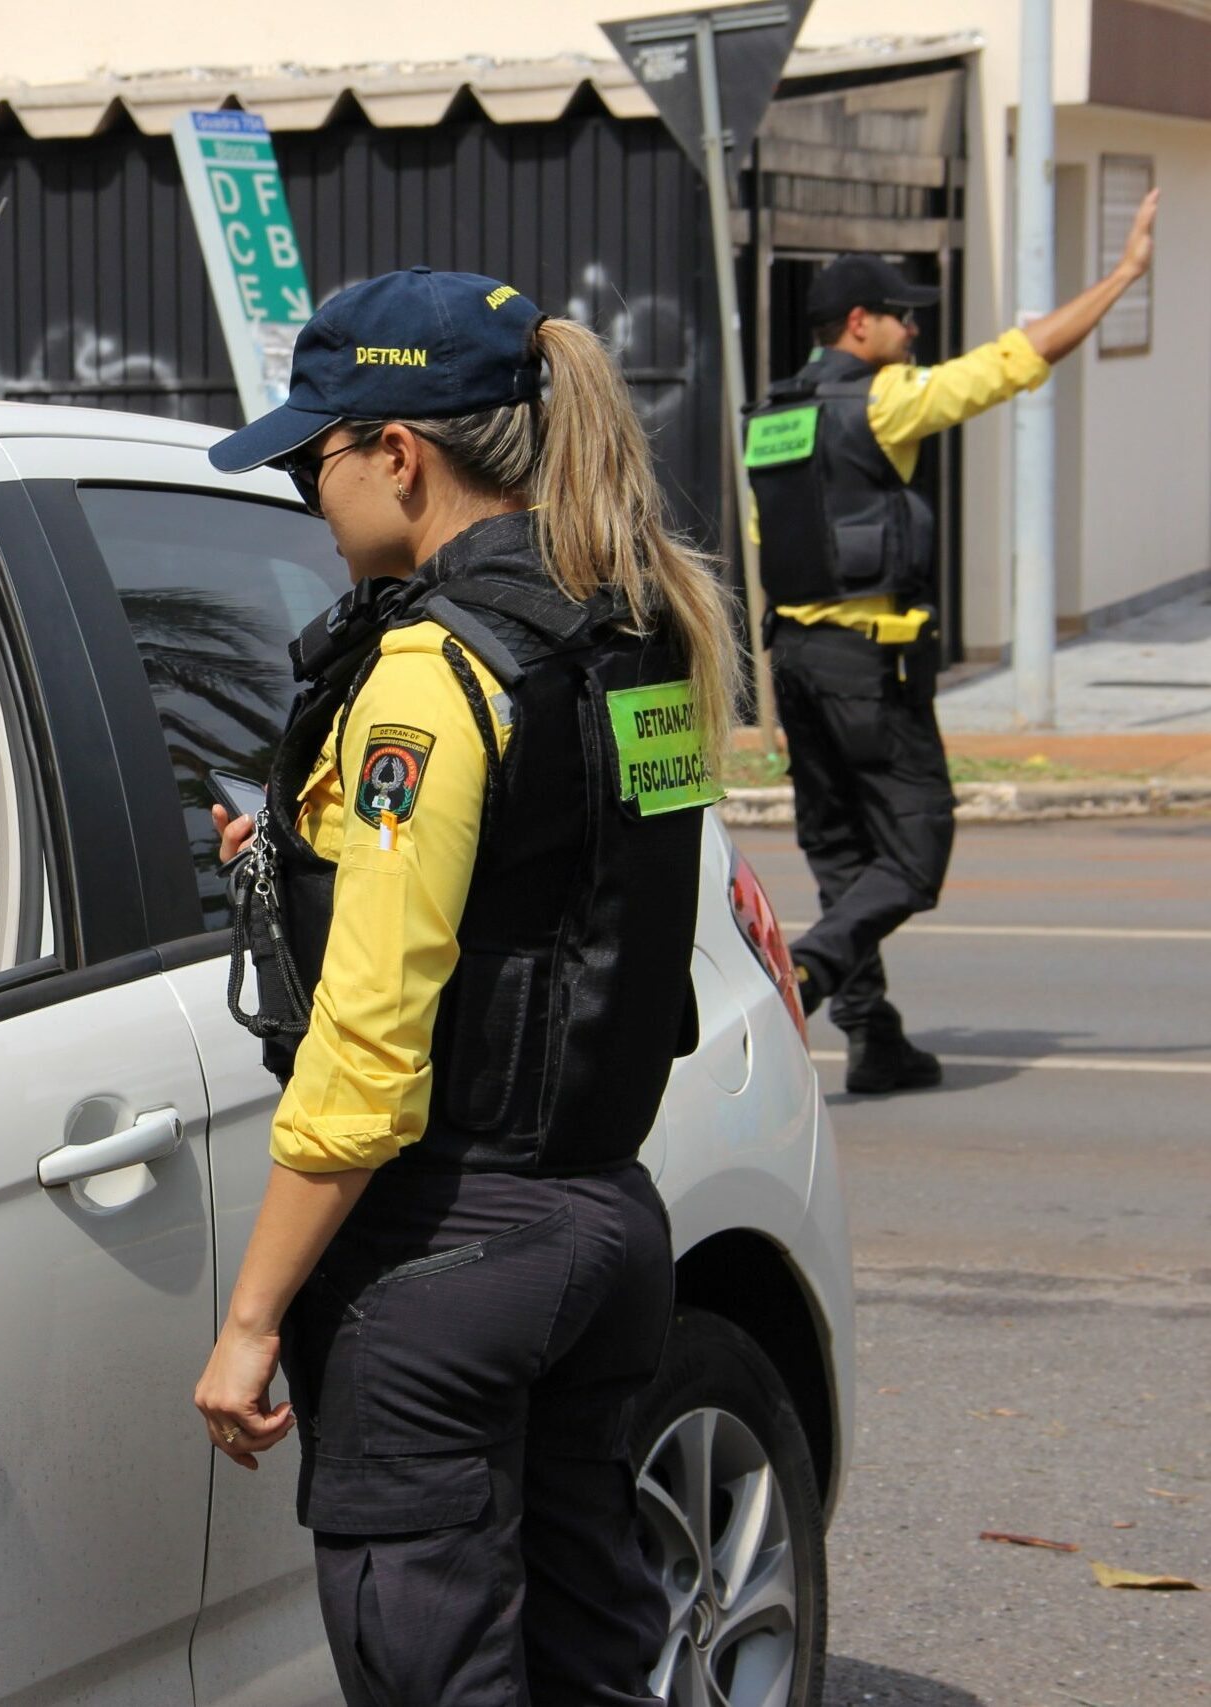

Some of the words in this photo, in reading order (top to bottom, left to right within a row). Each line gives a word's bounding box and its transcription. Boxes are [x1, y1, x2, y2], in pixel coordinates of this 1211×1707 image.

[210, 171, 242, 214] D
[252, 174, 279, 216] F
[226, 222, 256, 266] C
[266, 225, 299, 268] B
[238, 275, 268, 318] E
[355, 346, 427, 368] DETRAN
[379, 728, 421, 740] DETRAN-DF
[628, 746, 712, 794] FISCALIZAÇÃ
